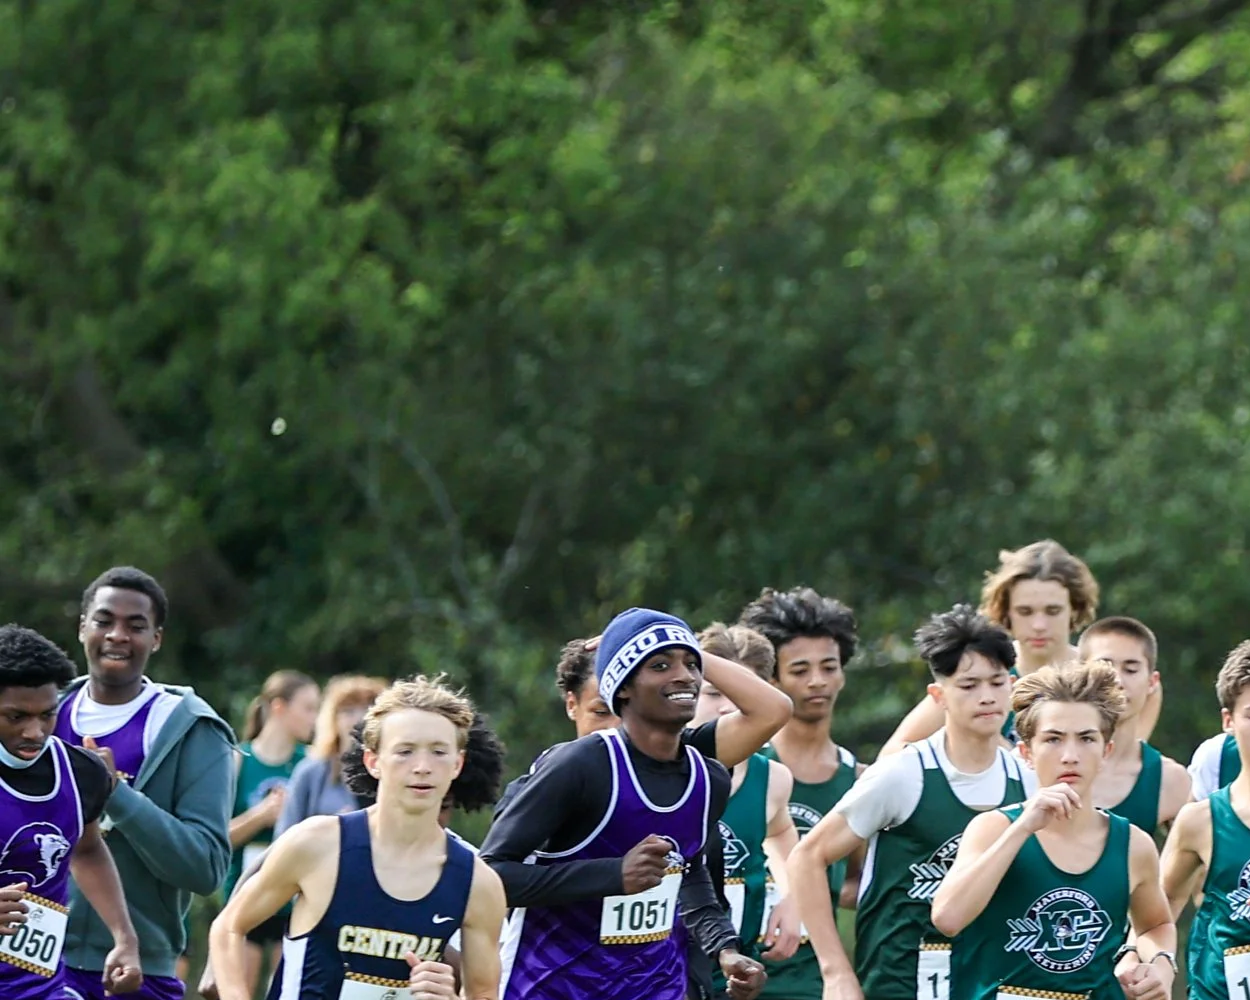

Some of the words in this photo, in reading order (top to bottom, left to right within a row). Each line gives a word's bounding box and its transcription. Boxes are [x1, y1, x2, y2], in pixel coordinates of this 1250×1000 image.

[602, 629, 659, 697] GERO
[613, 898, 669, 931] 1051
[1031, 890, 1096, 914] WATERFORD
[0, 924, 58, 964] 050
[337, 924, 444, 962] CENTRAL
[1033, 942, 1097, 971] KETTERING
